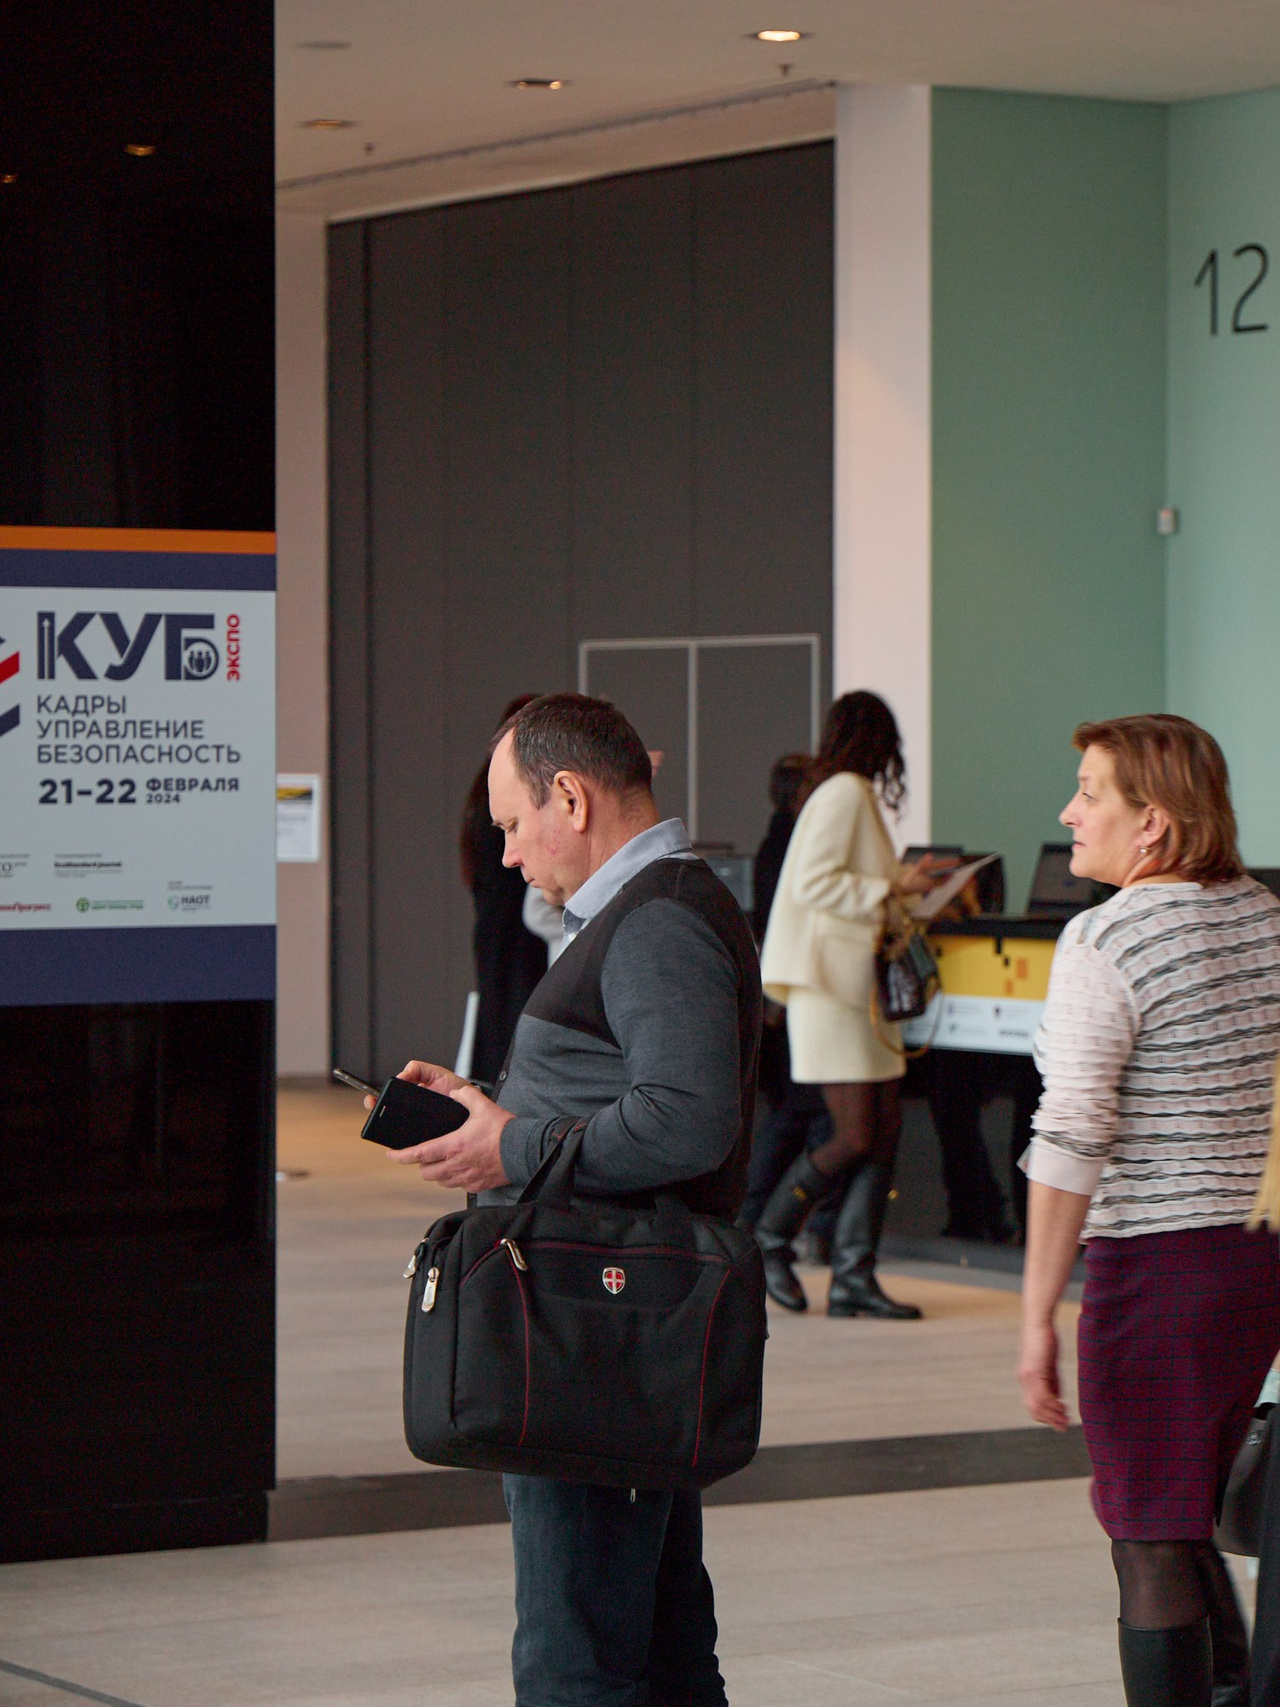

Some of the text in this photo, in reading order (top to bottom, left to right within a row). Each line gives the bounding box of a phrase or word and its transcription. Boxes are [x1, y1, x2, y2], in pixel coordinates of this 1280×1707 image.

[1194, 243, 1269, 336] 12
[37, 611, 220, 681] КУБ
[226, 614, 241, 682] ЭКСПО
[37, 695, 127, 717] КАДРЫ
[37, 720, 204, 739] УПРАВЛЕНИЕ
[37, 745, 241, 765] БЕЗОПАСНОСТЬ
[146, 778, 240, 792] ФЕВРАЛЯ
[146, 793, 181, 804] 2024
